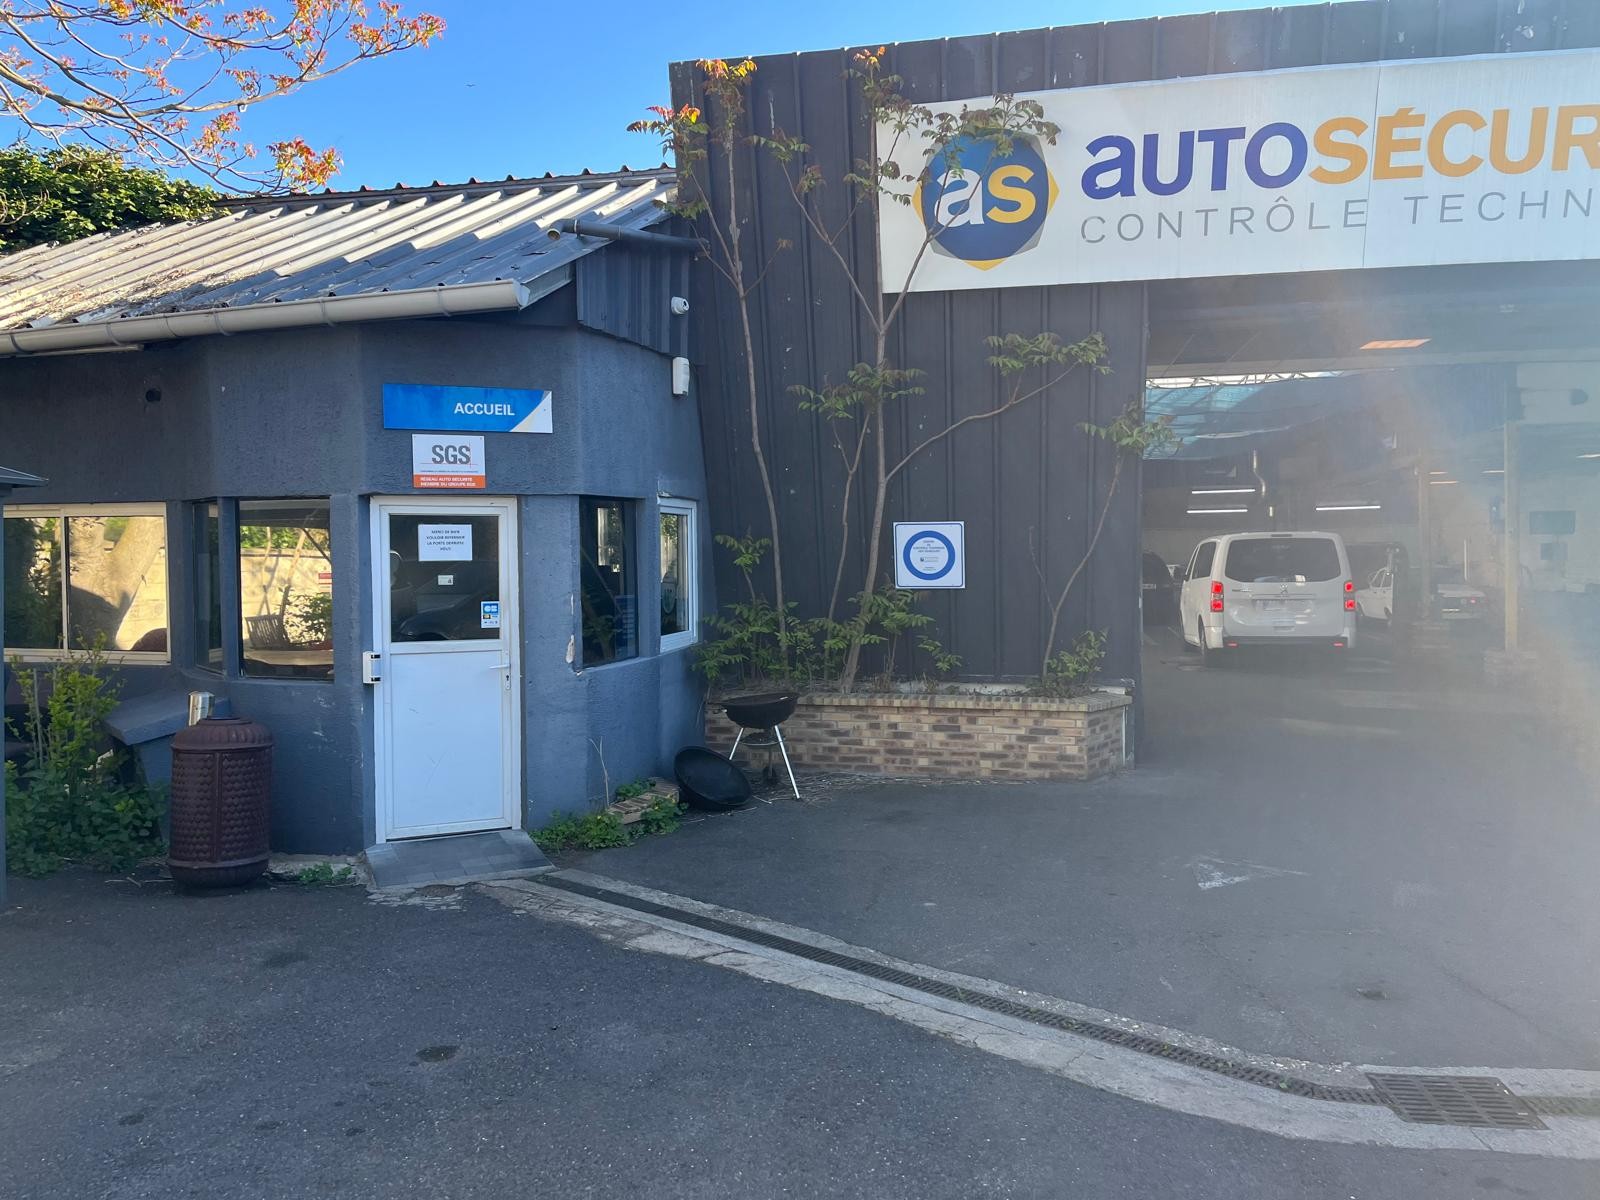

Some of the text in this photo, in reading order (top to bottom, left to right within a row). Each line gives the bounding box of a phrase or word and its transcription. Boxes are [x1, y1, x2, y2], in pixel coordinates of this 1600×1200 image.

[934, 165, 1037, 228] as
[1080, 188, 1593, 244] CONTRÔLE TECHN
[454, 402, 515, 416] ACCUEIL
[431, 444, 471, 465] SGS
